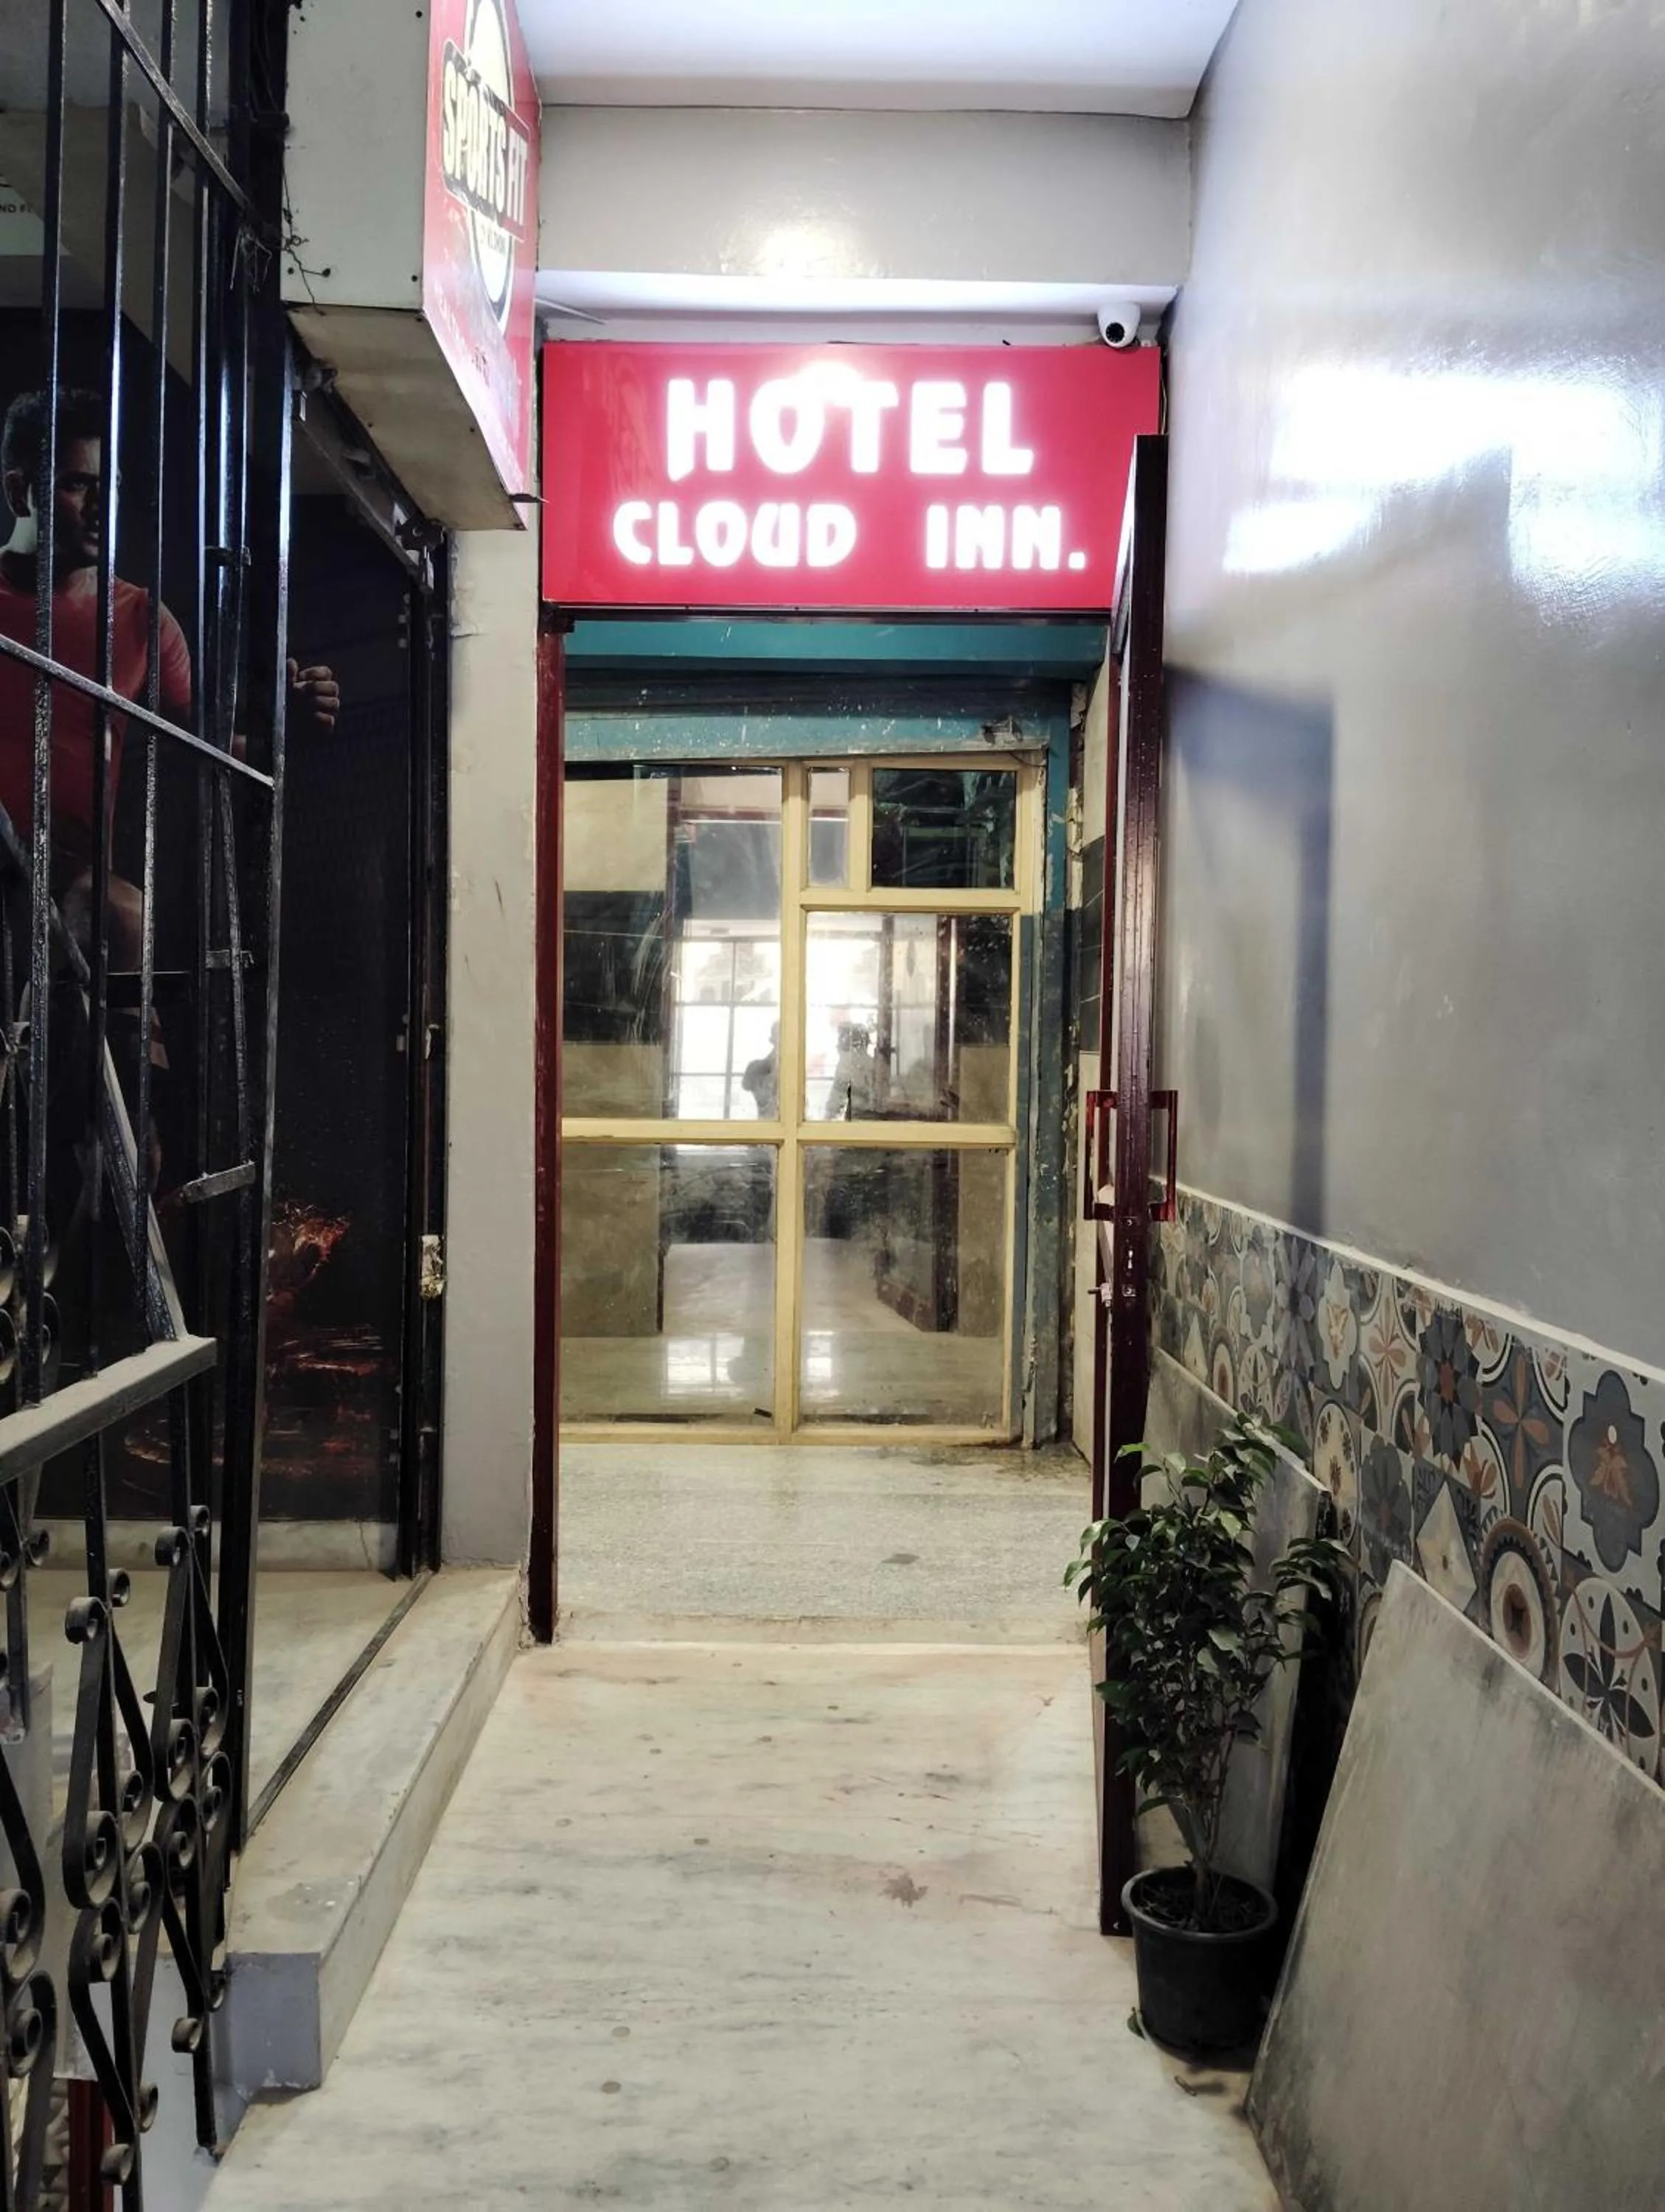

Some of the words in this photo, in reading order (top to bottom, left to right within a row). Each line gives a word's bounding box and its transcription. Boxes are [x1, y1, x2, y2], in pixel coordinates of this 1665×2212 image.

[666, 378, 1035, 482] HOTEL
[613, 500, 857, 568] CLOUD
[925, 504, 1085, 570] INN.
